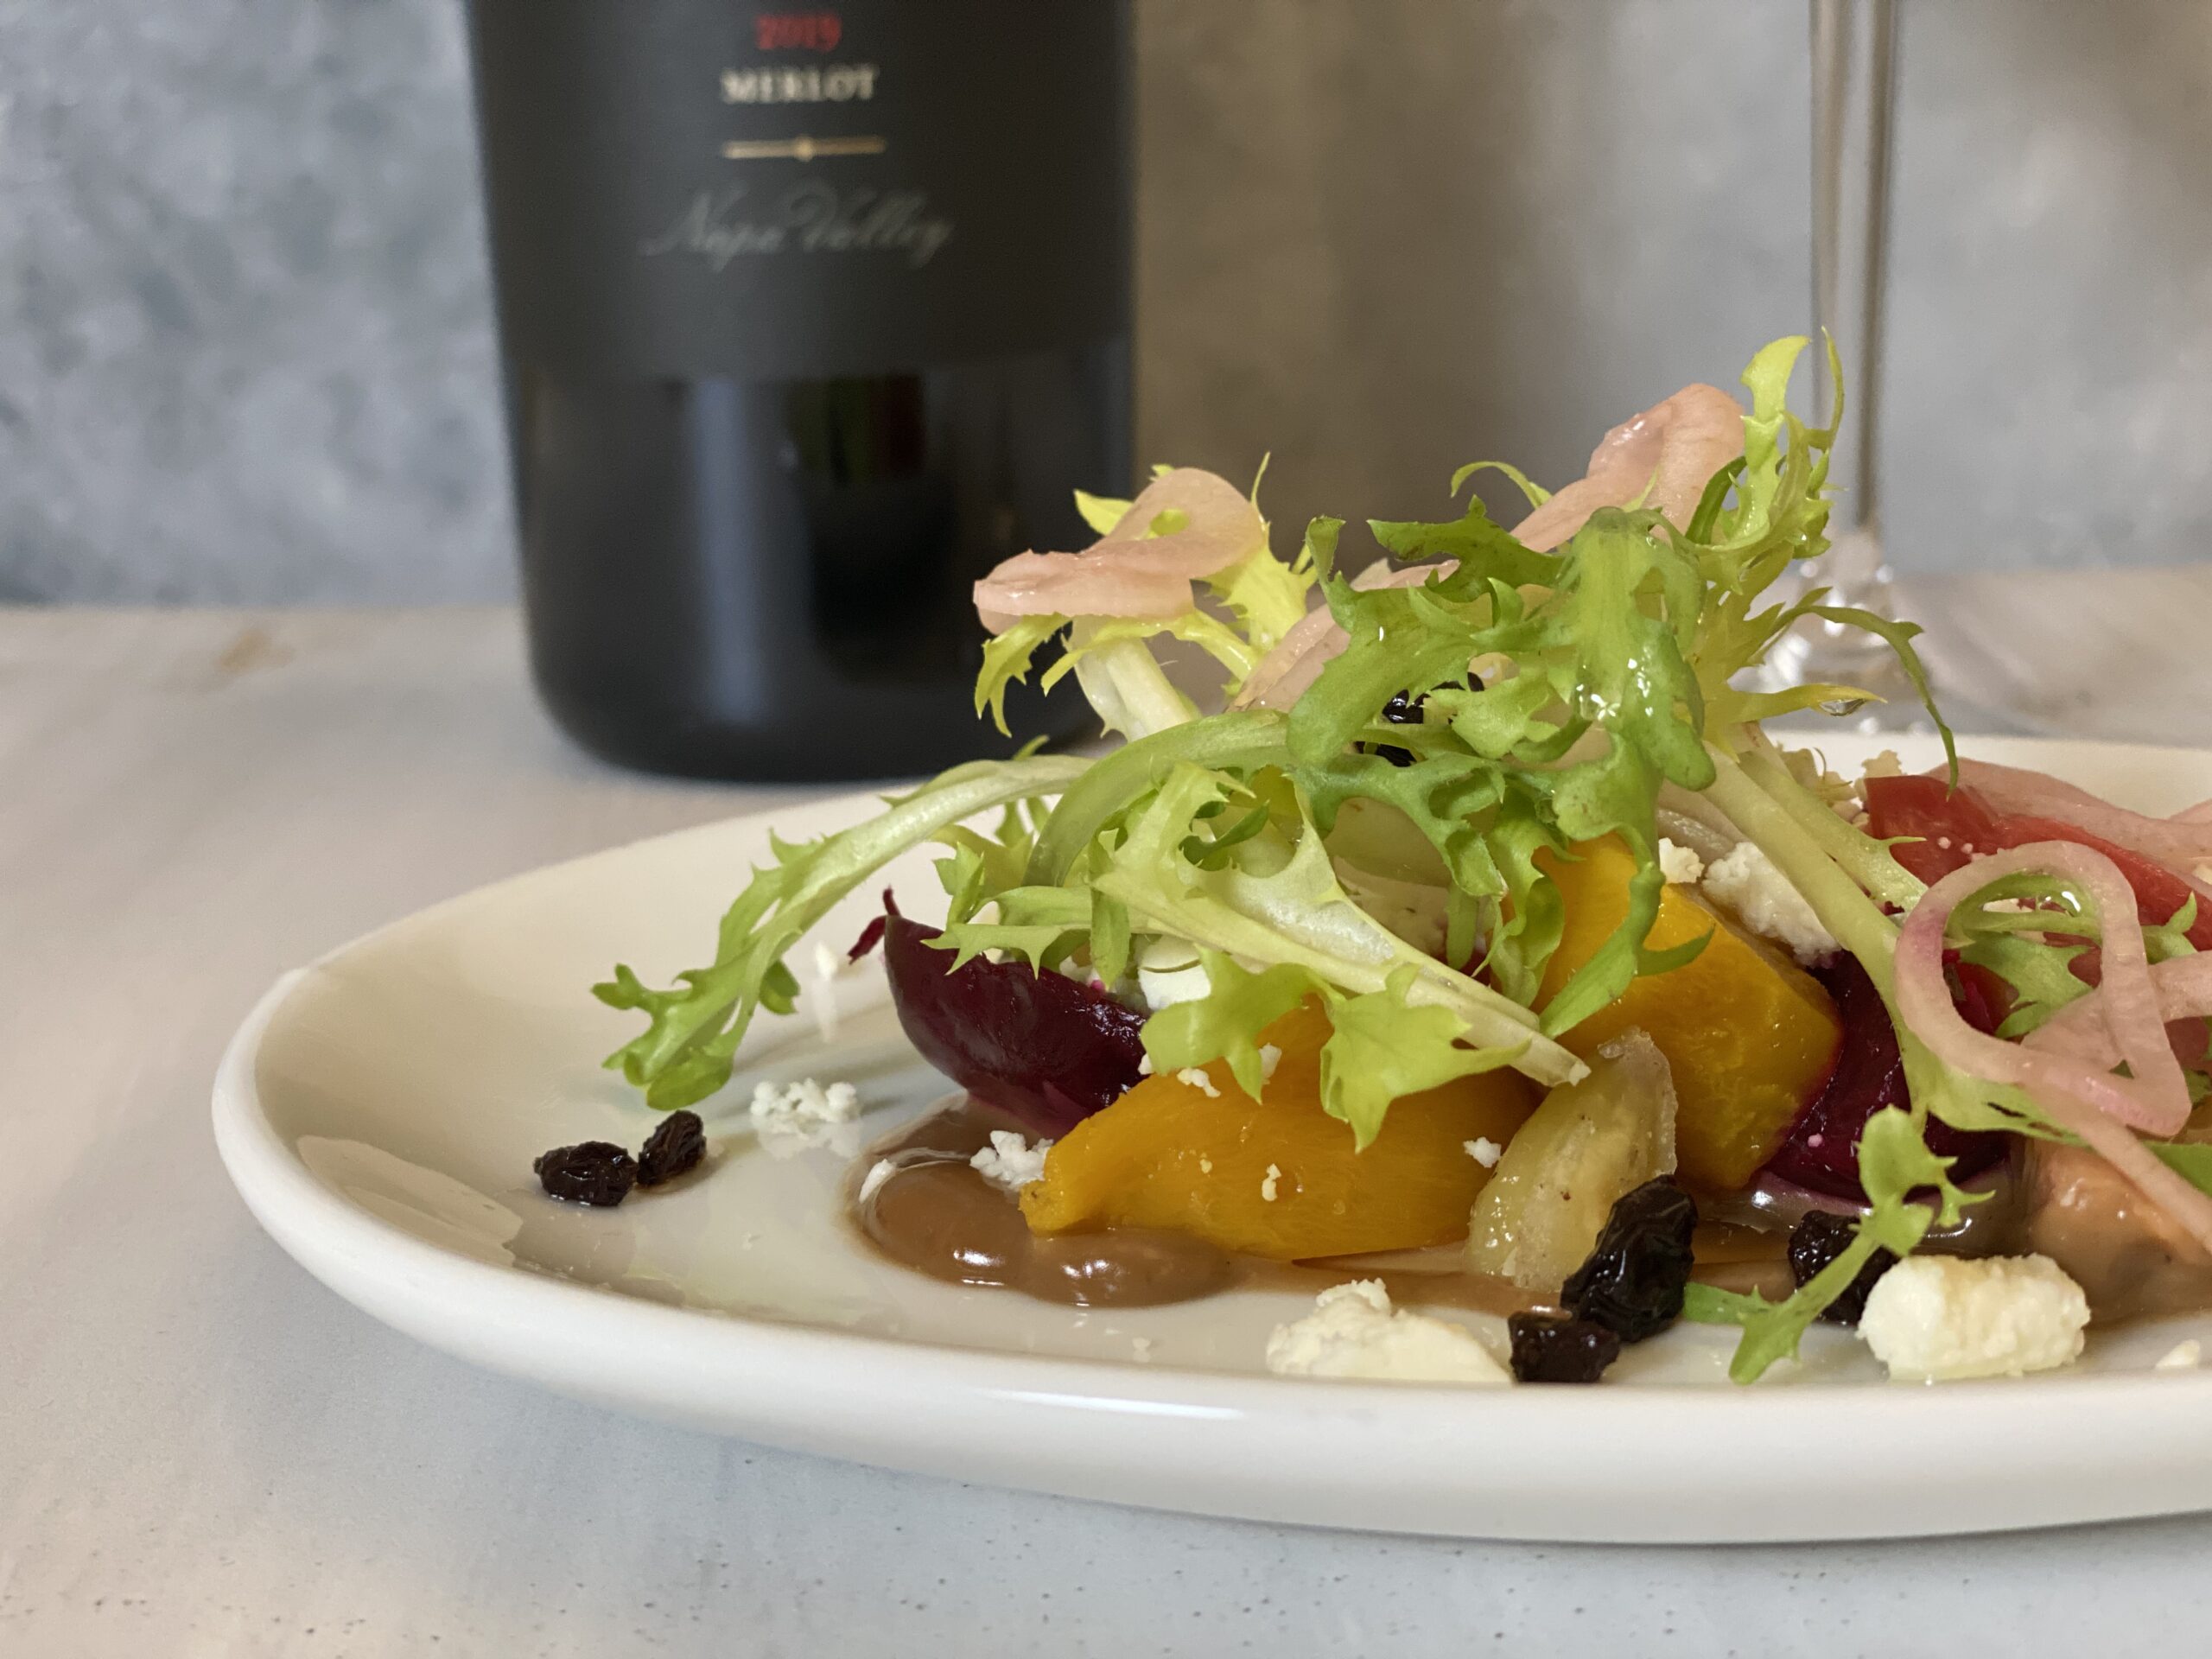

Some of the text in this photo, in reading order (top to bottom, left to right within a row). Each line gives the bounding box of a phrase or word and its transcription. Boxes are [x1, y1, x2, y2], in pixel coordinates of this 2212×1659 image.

[756, 13, 842, 52] 2019
[721, 64, 878, 104] MERLOT
[639, 178, 954, 271] Napa Valley
